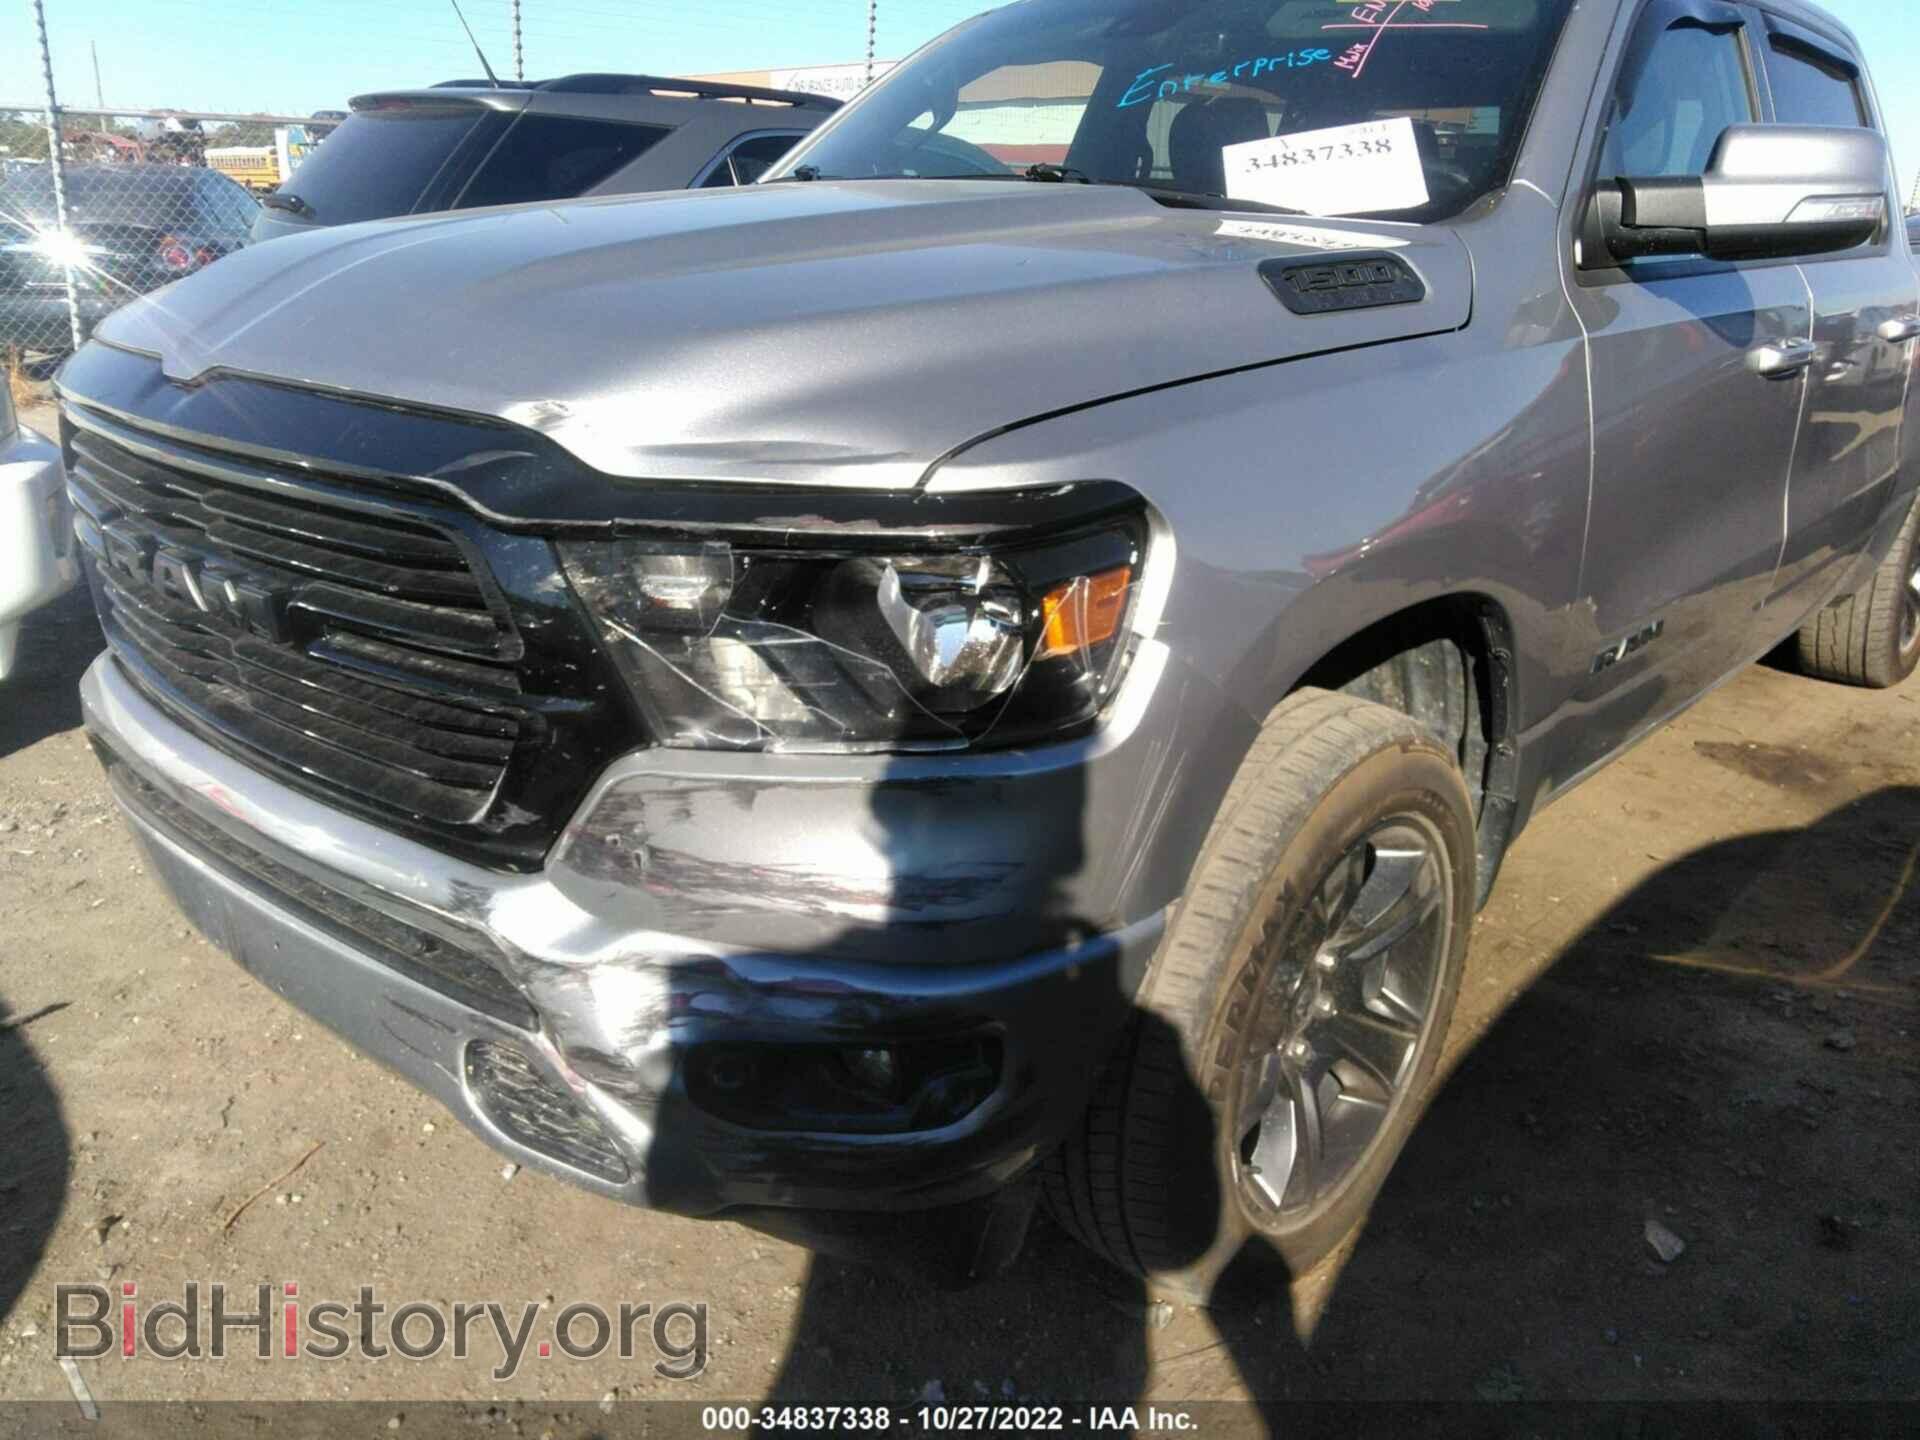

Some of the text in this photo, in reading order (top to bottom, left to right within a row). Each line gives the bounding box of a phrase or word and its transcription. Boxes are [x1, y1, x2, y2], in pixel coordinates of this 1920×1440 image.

[1245, 138, 1392, 173] 34837338
[1285, 263, 1396, 293] 1500
[101, 522, 290, 644] RAM
